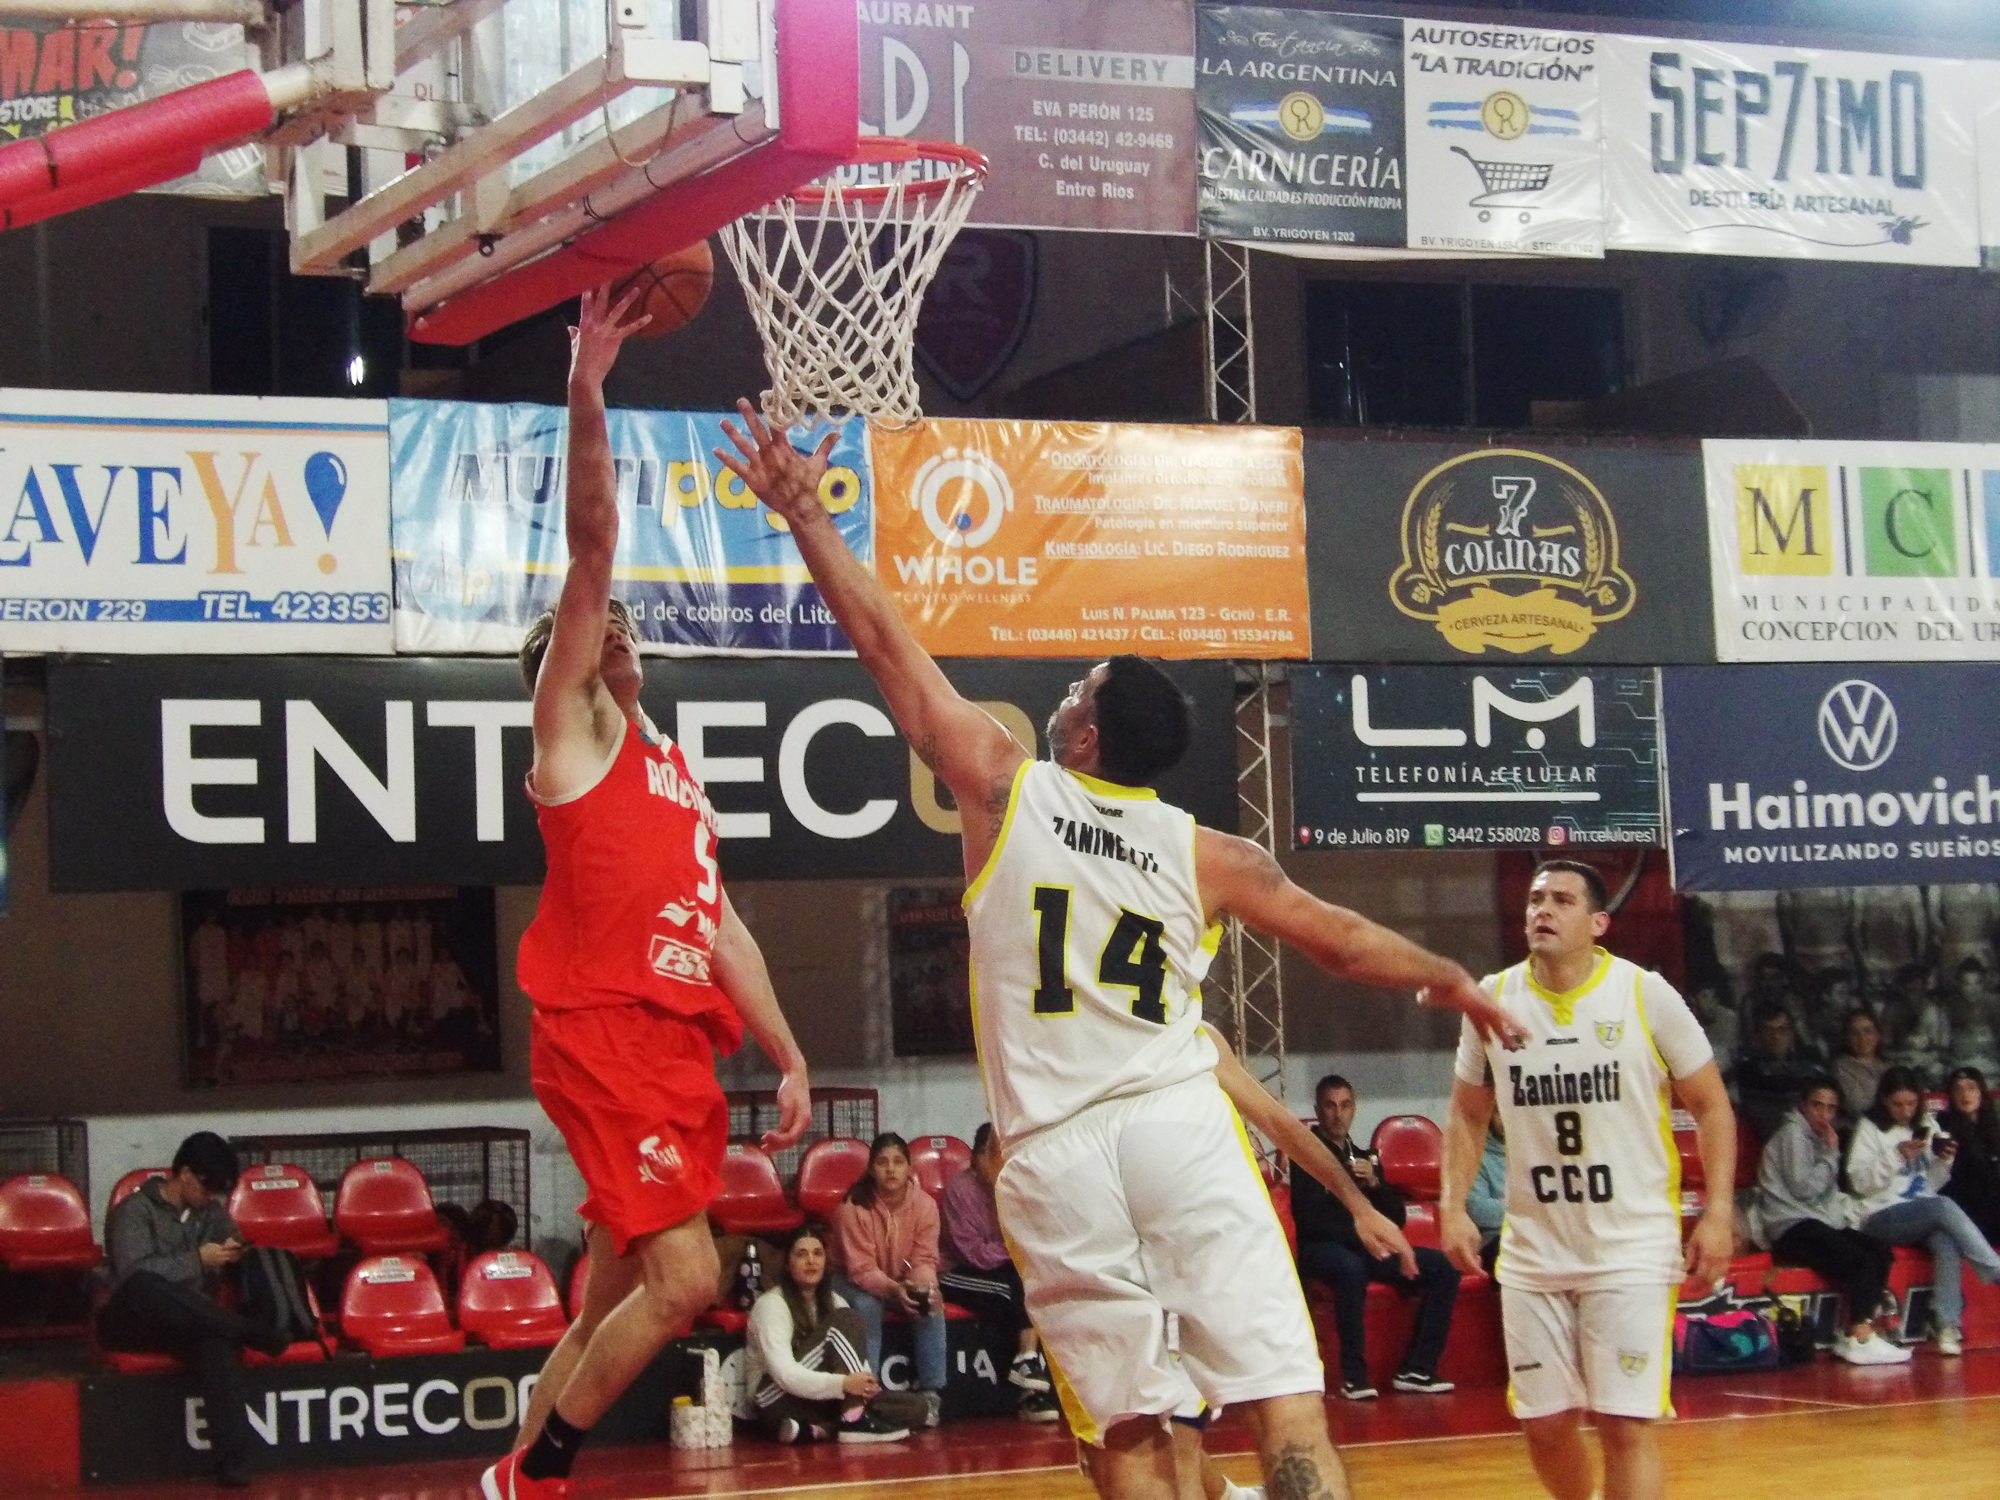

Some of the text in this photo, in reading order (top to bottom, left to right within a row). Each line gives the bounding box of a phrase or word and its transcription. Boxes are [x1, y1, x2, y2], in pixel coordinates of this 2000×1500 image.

[1410, 27, 1595, 54] AUTOSERVICIOS
[1015, 51, 1168, 82] DELIVERY
[1202, 57, 1398, 88] LA ARGENTINA
[1033, 100, 1062, 118] EVA
[1128, 106, 1154, 122] 125
[1014, 125, 1048, 142] TEL:
[1054, 127, 1109, 149] (03442)
[1038, 152, 1151, 177] C. del Uruguay
[1202, 147, 1401, 190] CARNICERÍA
[1055, 179, 1096, 198] Entre
[1302, 191, 1367, 209] PRODUCCIÓN
[1367, 196, 1402, 210] PROPIA
[1793, 193, 1896, 216] ARTESANAL
[1273, 227, 1330, 241] YRIGOYEN
[1440, 237, 1495, 249] YRIGOYEN
[1492, 475, 1538, 537] 7
[1158, 519, 1174, 530] en
[1178, 517, 1233, 531] miembro
[1235, 518, 1289, 533] superior
[1744, 487, 1823, 556] M
[1883, 488, 1935, 558] C
[1172, 541, 1214, 557] DIEGO
[1216, 541, 1290, 559] RODRIGUEZ
[1444, 538, 1582, 577] COLINAS
[892, 555, 1039, 586] WHOLE
[0, 599, 147, 622] ERON 229
[200, 593, 390, 622] TEL. 423353
[653, 601, 680, 623] de
[686, 603, 754, 624] cobros
[759, 602, 793, 625] del
[1082, 606, 1110, 621] LUIS
[1131, 606, 1177, 621] PALMA
[1181, 607, 1206, 621] 123
[1265, 608, 1293, 622] E.R.
[1081, 627, 1130, 642] 421437
[1454, 613, 1579, 633] CERVEZA ARTESANAL
[1741, 621, 1899, 641] CONCEPCION
[1917, 622, 1963, 641] DEL
[1351, 674, 1597, 750] LM
[1356, 761, 1598, 784] TELEFONÍA CELULAR
[1708, 774, 2000, 831] Haimovich
[1314, 826, 1410, 845] 9 de Julio 819
[1447, 826, 1541, 844] 3442 558028
[1723, 842, 1900, 864] MOVILIZANDO
[1031, 882, 1169, 1025] 14
[1509, 1060, 1621, 1107] Zaninetti
[1555, 1111, 1584, 1156] 8
[1531, 1164, 1614, 1204] CCO
[185, 1374, 541, 1450] ENTRECO
